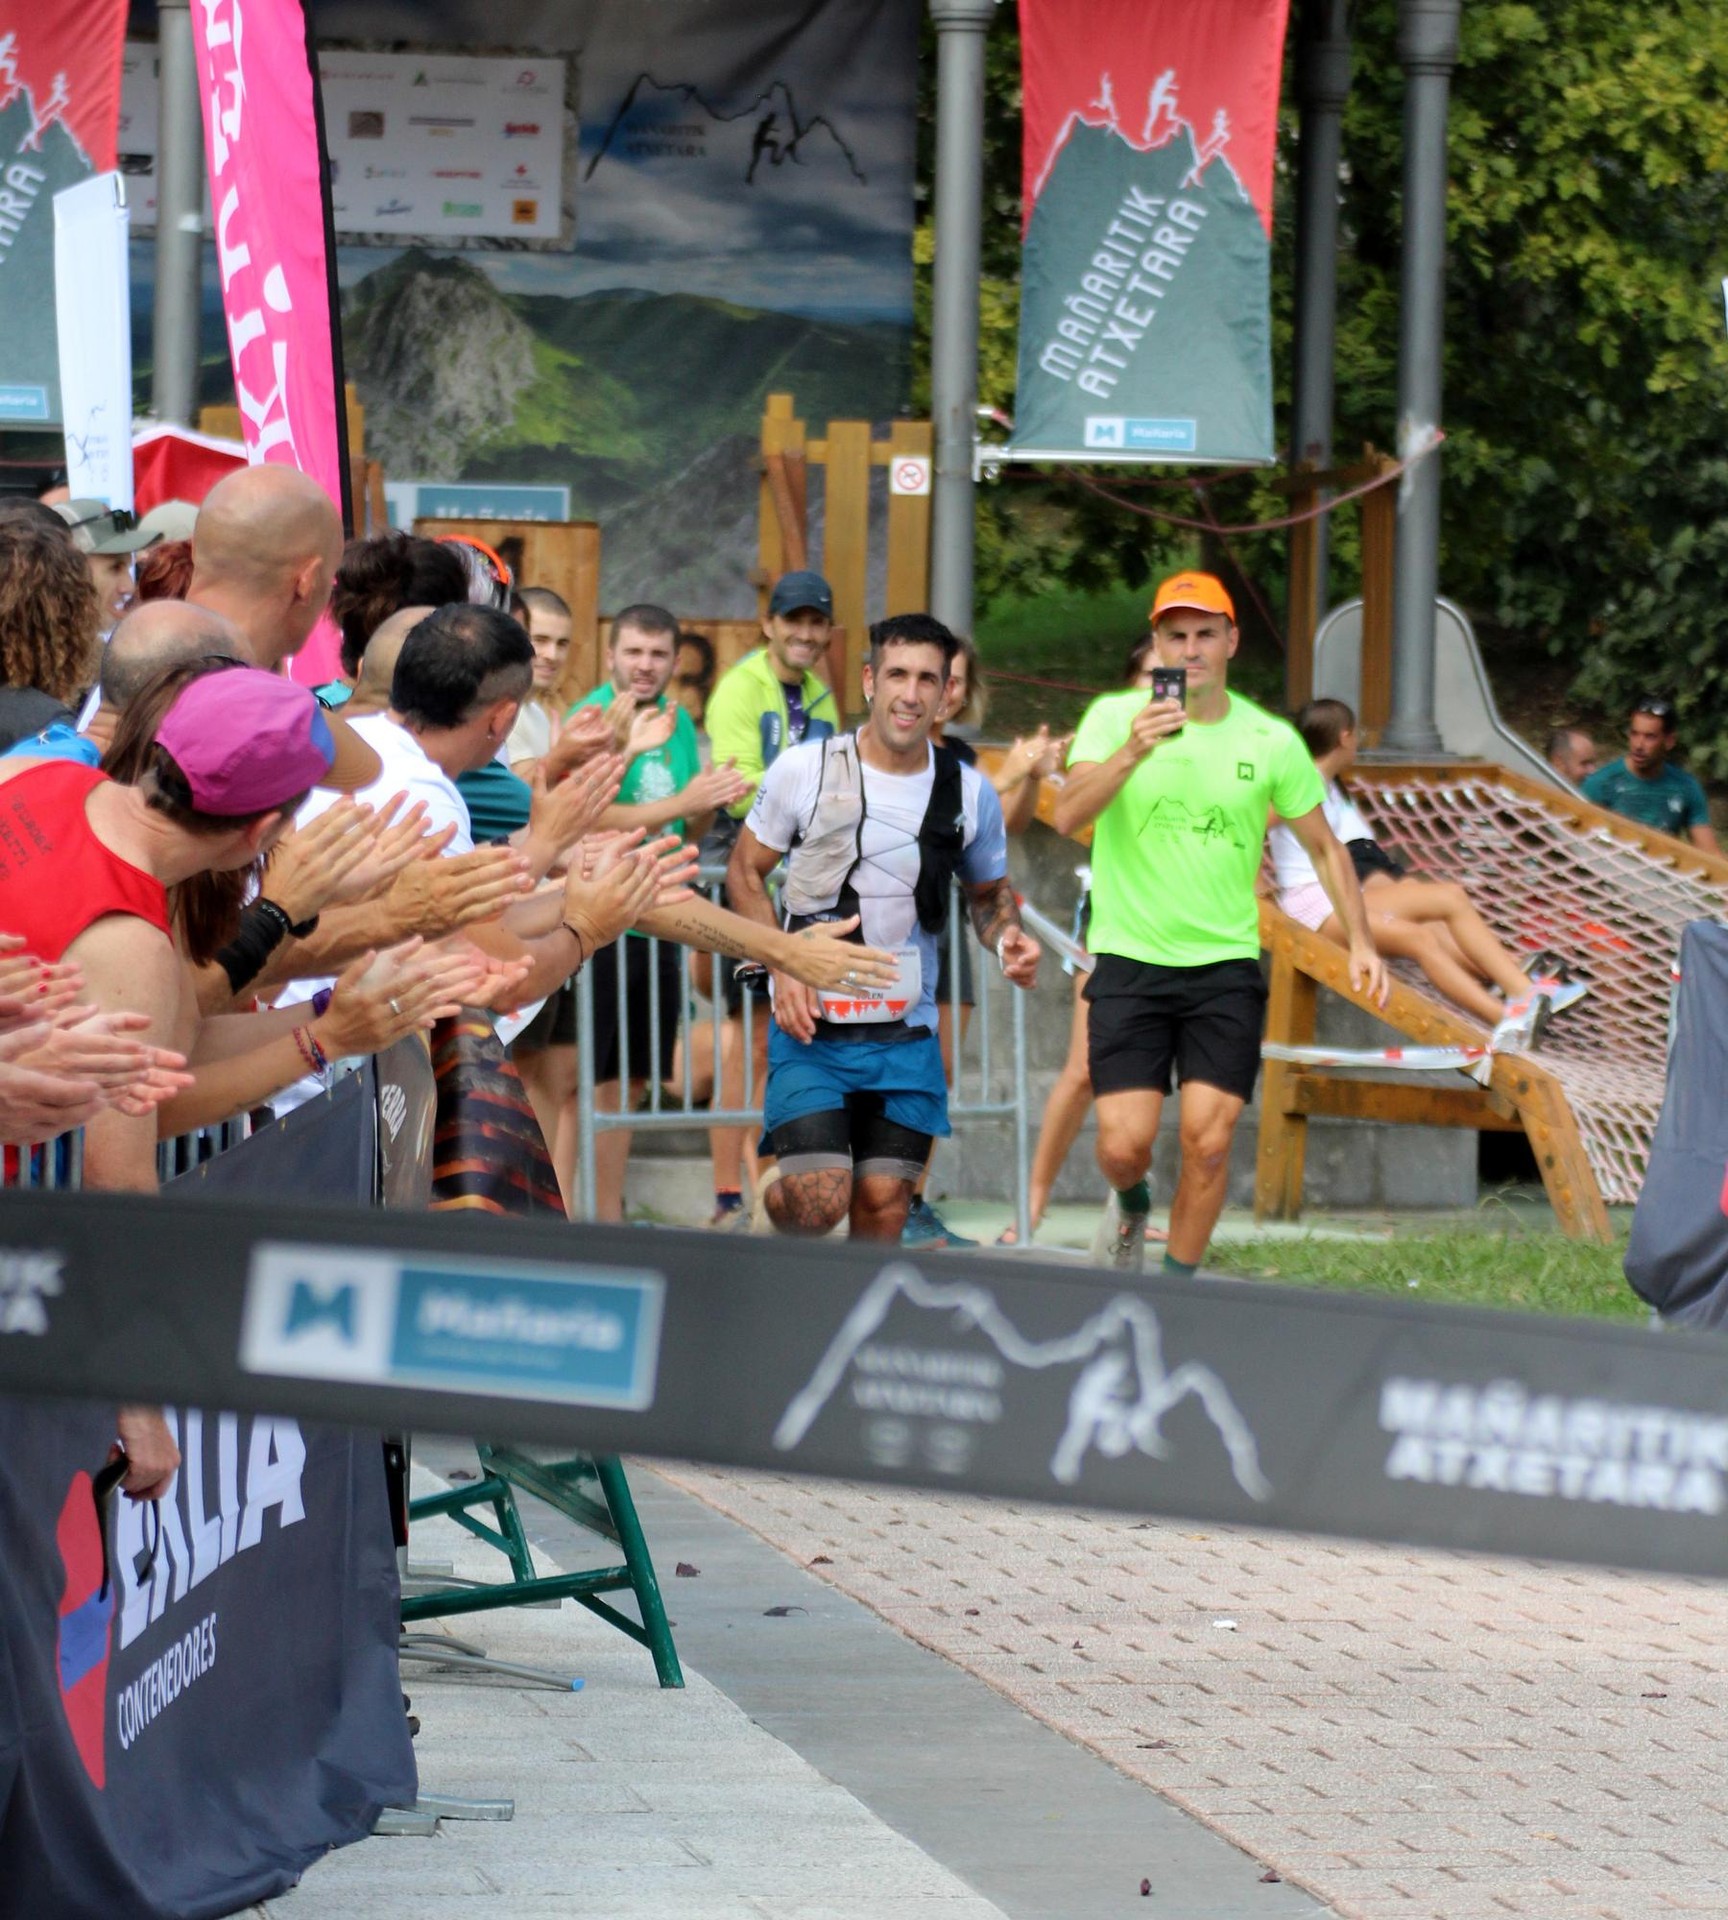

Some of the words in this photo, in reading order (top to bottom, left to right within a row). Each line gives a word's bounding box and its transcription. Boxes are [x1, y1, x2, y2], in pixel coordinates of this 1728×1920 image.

[1038, 184, 1166, 381] MAÑARITIK
[1076, 198, 1209, 399] ATXETARA
[117, 1611, 217, 1750] CONTENEDORES
